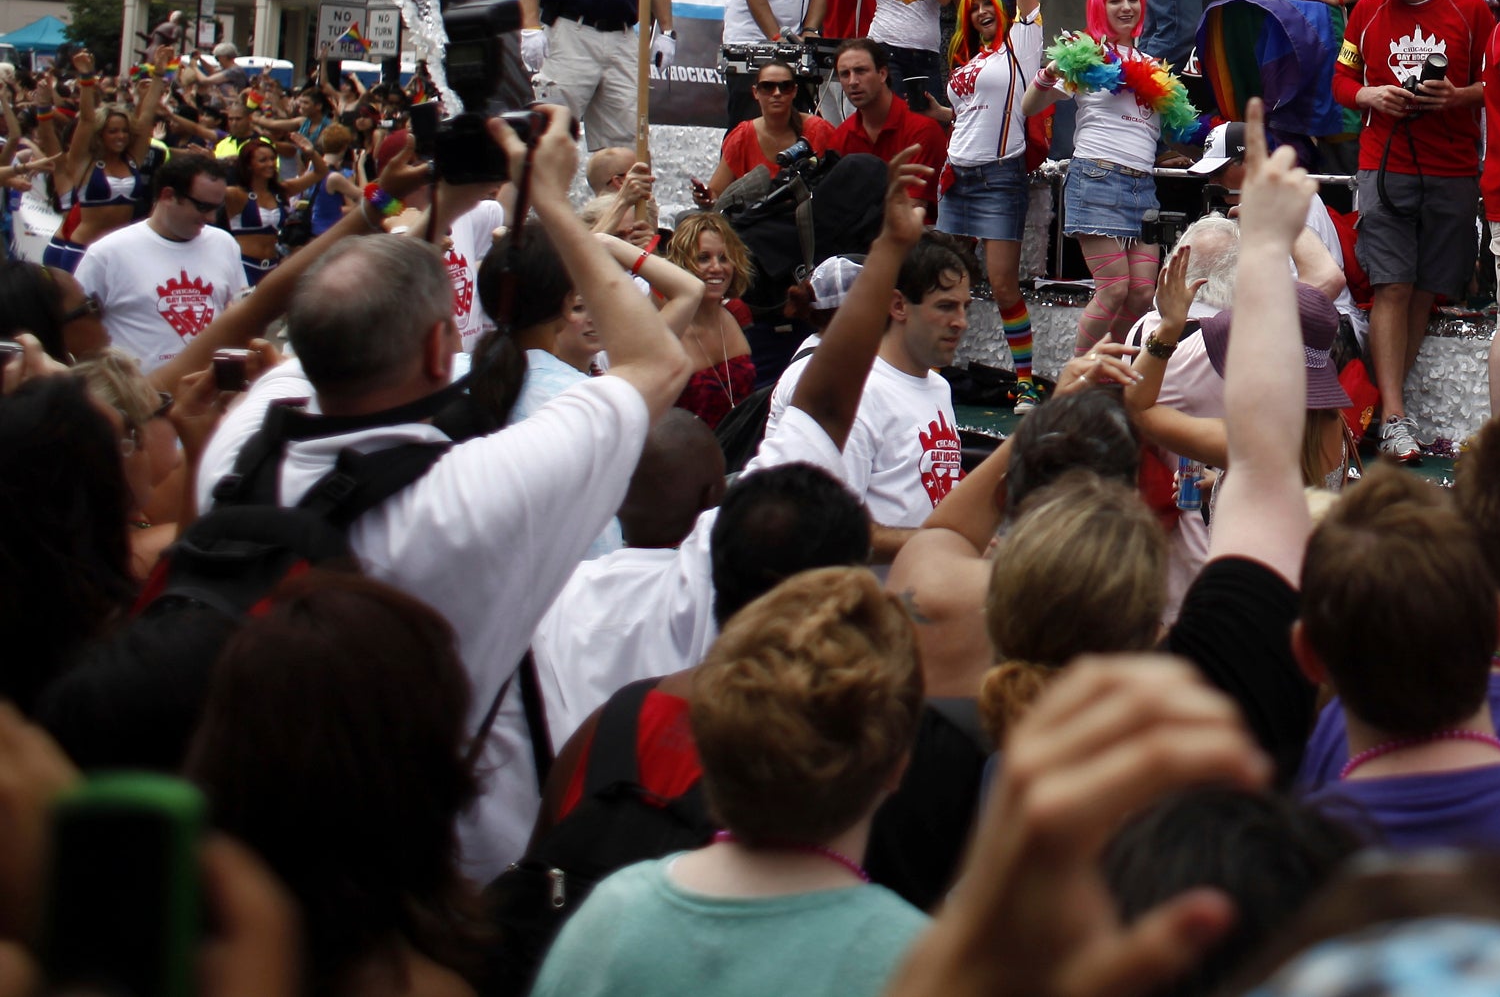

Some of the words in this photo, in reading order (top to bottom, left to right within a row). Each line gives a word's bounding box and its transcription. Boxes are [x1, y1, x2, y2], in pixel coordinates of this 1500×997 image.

[333, 10, 352, 22] NO
[378, 14, 390, 23] NO
[374, 27, 393, 36] TURN
[382, 41, 395, 49] RED
[648, 64, 668, 80] AY
[171, 288, 201, 296] CHICAGO
